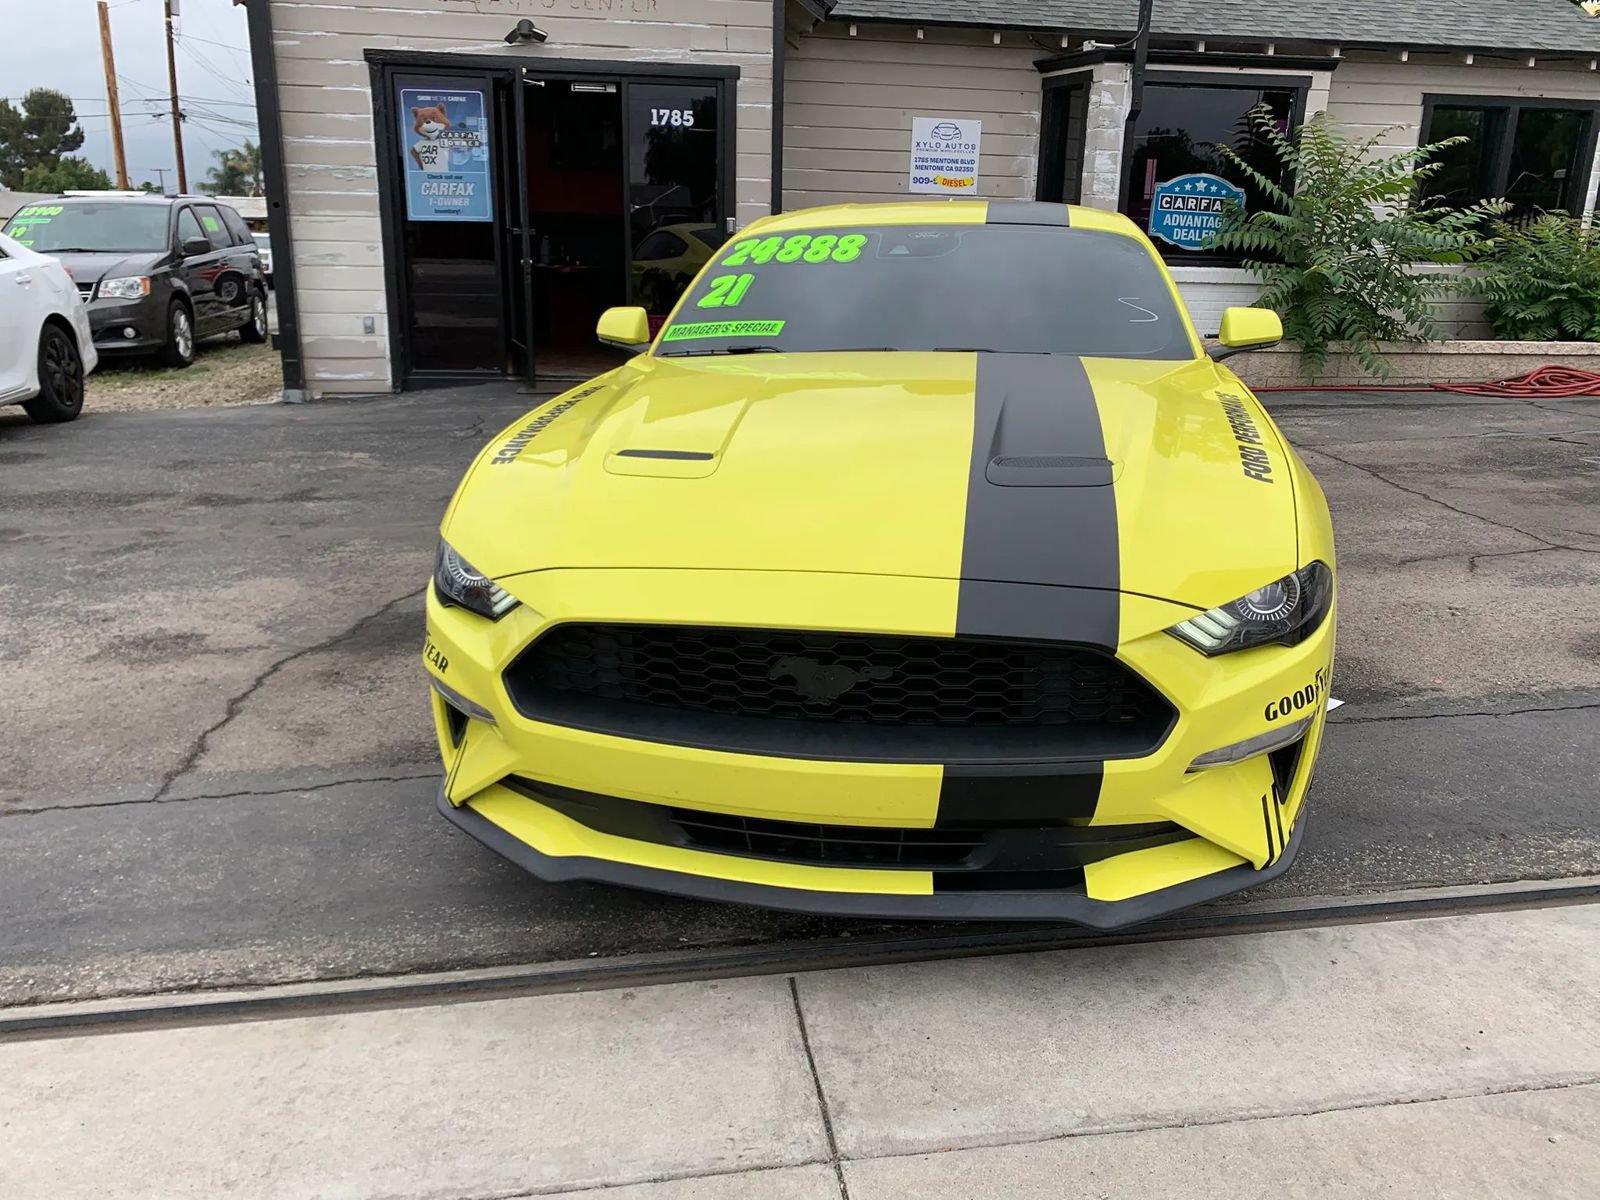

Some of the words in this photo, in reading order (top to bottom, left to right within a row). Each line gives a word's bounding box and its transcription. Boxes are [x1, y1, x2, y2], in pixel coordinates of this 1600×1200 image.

[651, 109, 694, 127] 1785
[441, 132, 480, 140] CARFAX
[421, 145, 438, 155] CAR
[421, 182, 475, 196] CARFAX
[942, 178, 966, 187] DIESEL
[429, 198, 470, 206] 1-OWNER
[1162, 197, 1222, 211] CARFA
[1163, 214, 1229, 228] ADVANTAG
[721, 234, 868, 266] 24888
[697, 273, 755, 308] 21
[671, 324, 730, 337] MANAGER'S
[731, 321, 779, 334] SPECIAL
[1238, 445, 1274, 484] FORD
